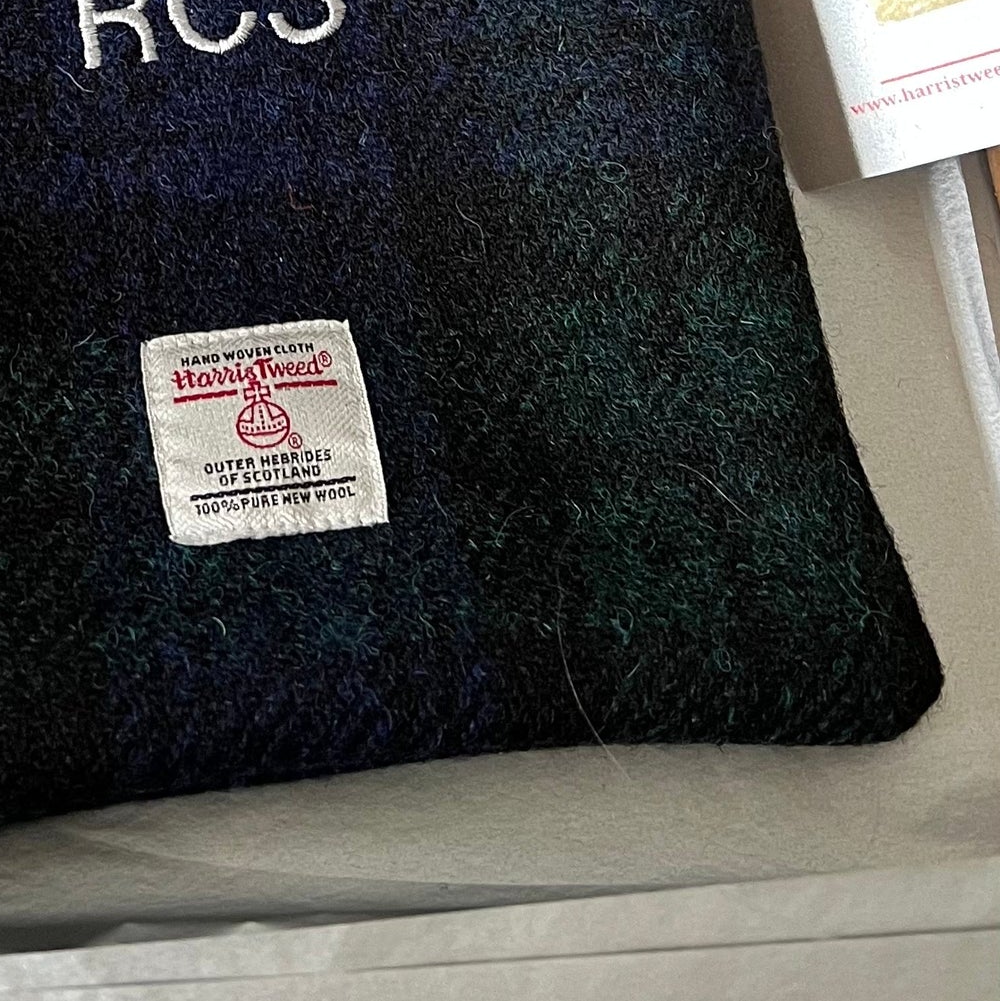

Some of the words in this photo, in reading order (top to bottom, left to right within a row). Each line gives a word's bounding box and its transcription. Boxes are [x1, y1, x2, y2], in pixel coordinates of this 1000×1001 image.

[181, 353, 220, 367] HAND
[221, 346, 272, 362] WOVEN
[273, 342, 315, 355] CLOTH
[204, 457, 255, 475] OUTER
[260, 449, 332, 468] HEBRIDES
[219, 473, 238, 487] OF
[243, 465, 322, 484] SCOTLAND
[195, 498, 240, 516] 100%
[242, 493, 279, 510] PURE
[282, 491, 312, 506] NEW
[315, 486, 356, 502] WOOL
